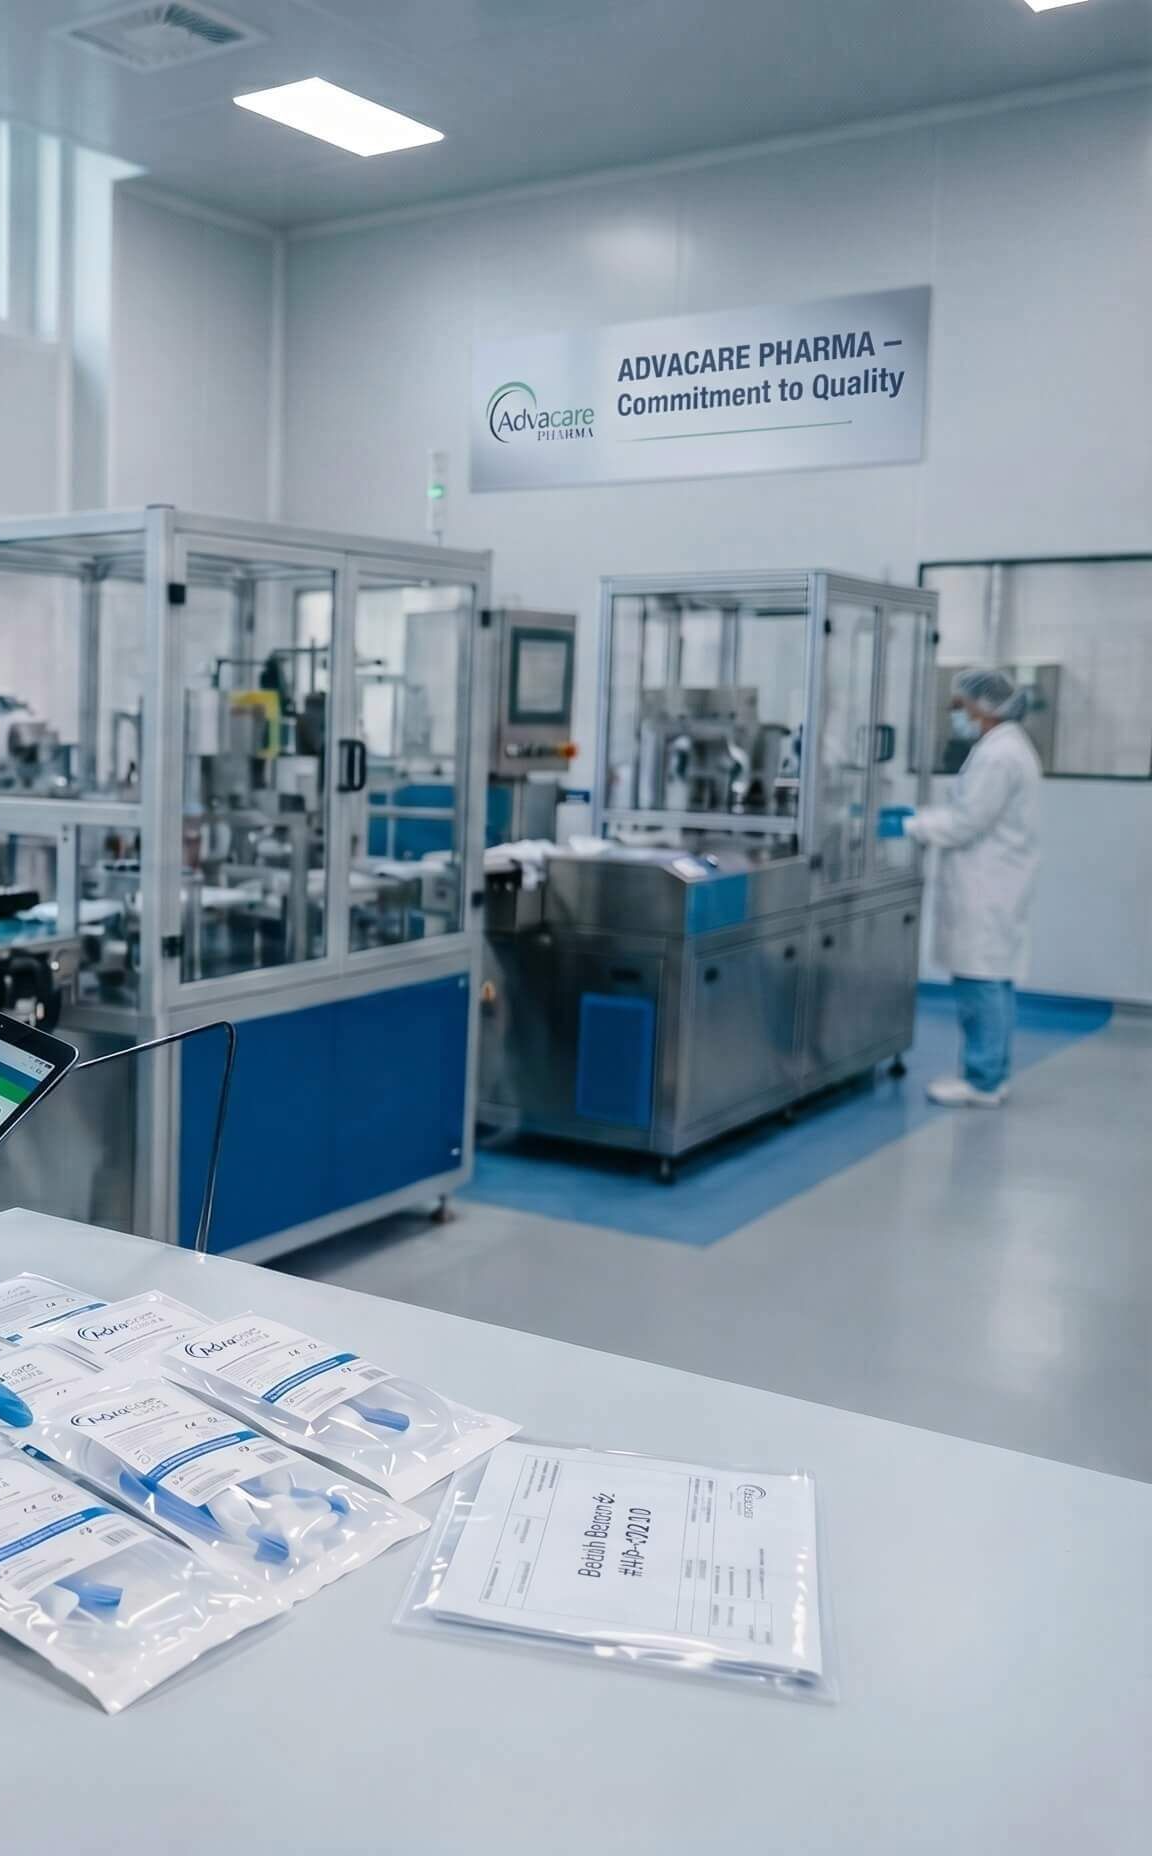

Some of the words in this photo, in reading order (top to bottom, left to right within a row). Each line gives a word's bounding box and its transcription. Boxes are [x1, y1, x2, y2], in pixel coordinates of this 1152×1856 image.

[617, 345, 751, 382] ADVACARE
[758, 331, 875, 368] PHARMA
[617, 379, 771, 417] Commitment
[779, 378, 803, 402] to
[812, 367, 905, 400] Quality
[497, 408, 595, 433] Advacare
[537, 428, 594, 441] PHARMA
